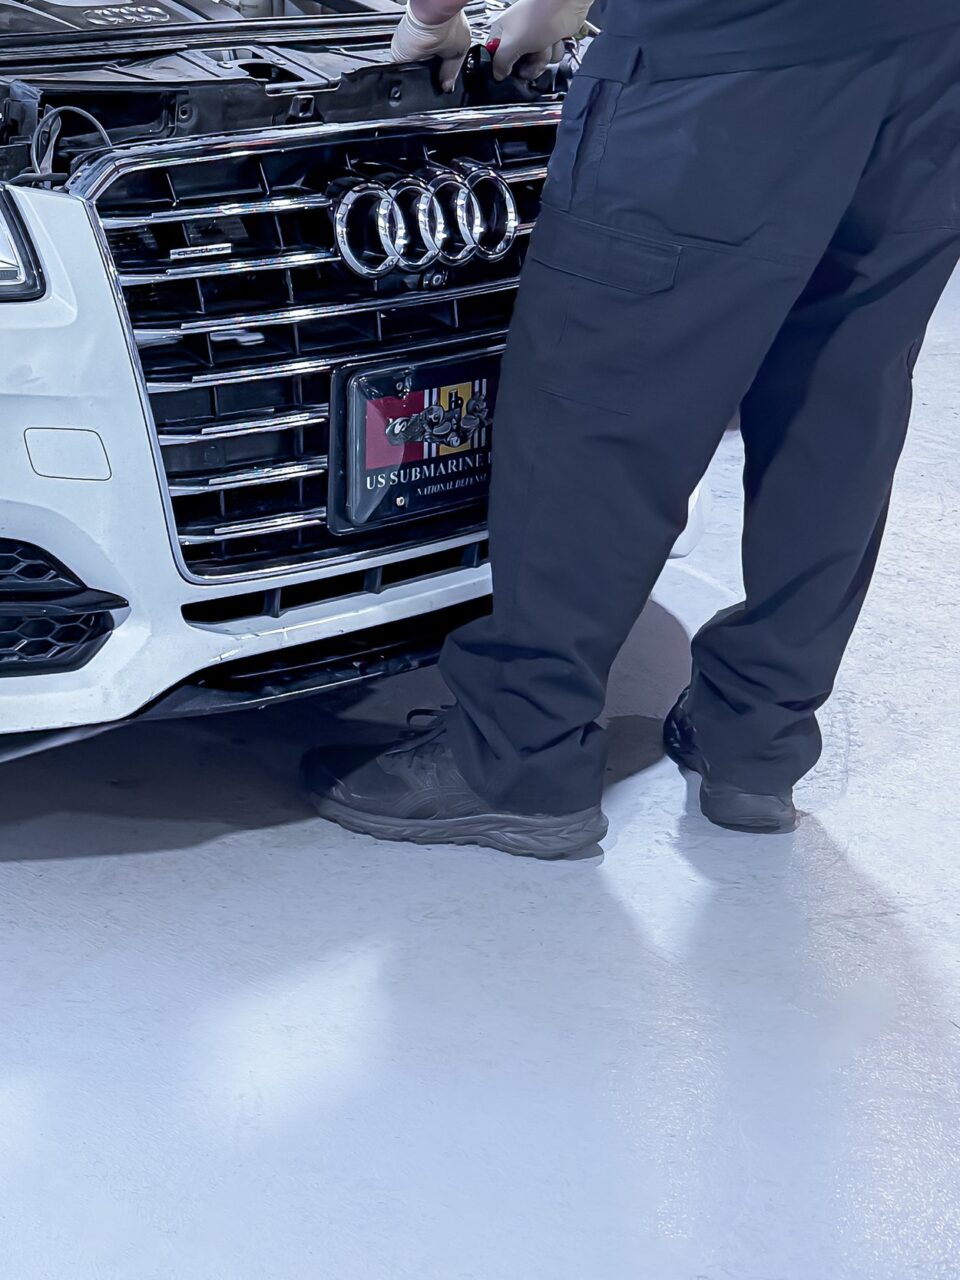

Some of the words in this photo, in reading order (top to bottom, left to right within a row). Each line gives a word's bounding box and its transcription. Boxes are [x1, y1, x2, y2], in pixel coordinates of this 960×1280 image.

[366, 473, 386, 490] US
[389, 453, 484, 486] SUBMARINE
[417, 480, 453, 496] NATIONAL
